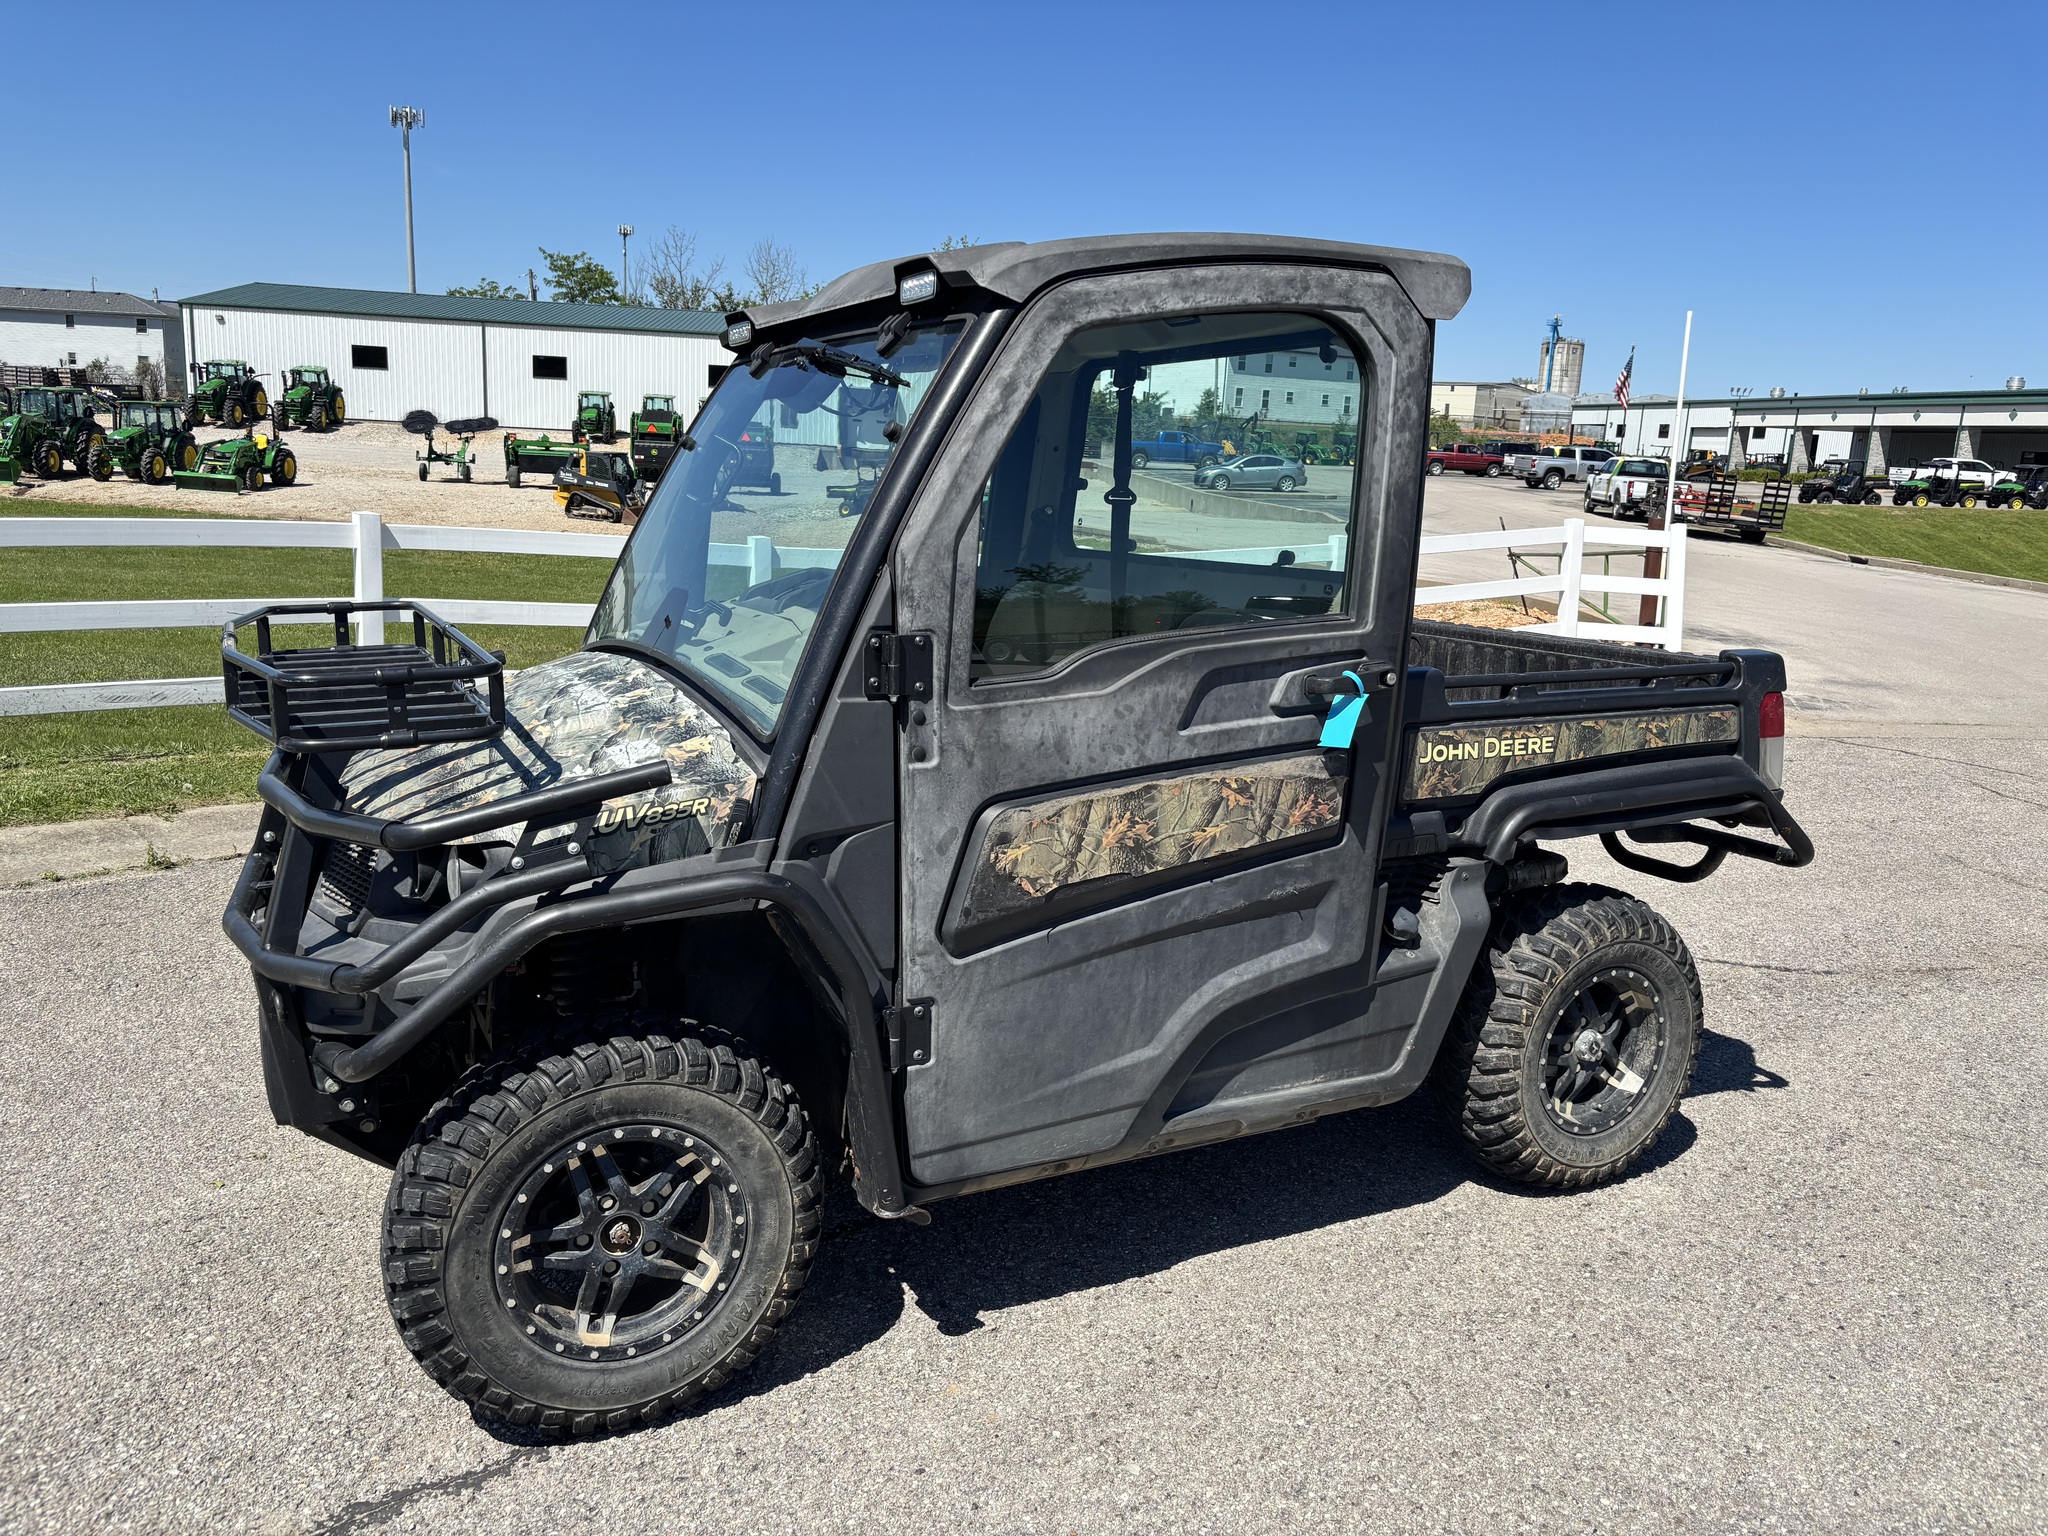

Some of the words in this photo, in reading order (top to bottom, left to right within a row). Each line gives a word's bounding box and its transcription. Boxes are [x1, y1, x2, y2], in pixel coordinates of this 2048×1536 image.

[1419, 740, 1480, 764] JOHN
[1482, 736, 1555, 759] DEERE
[667, 1282, 768, 1384] KANATI
